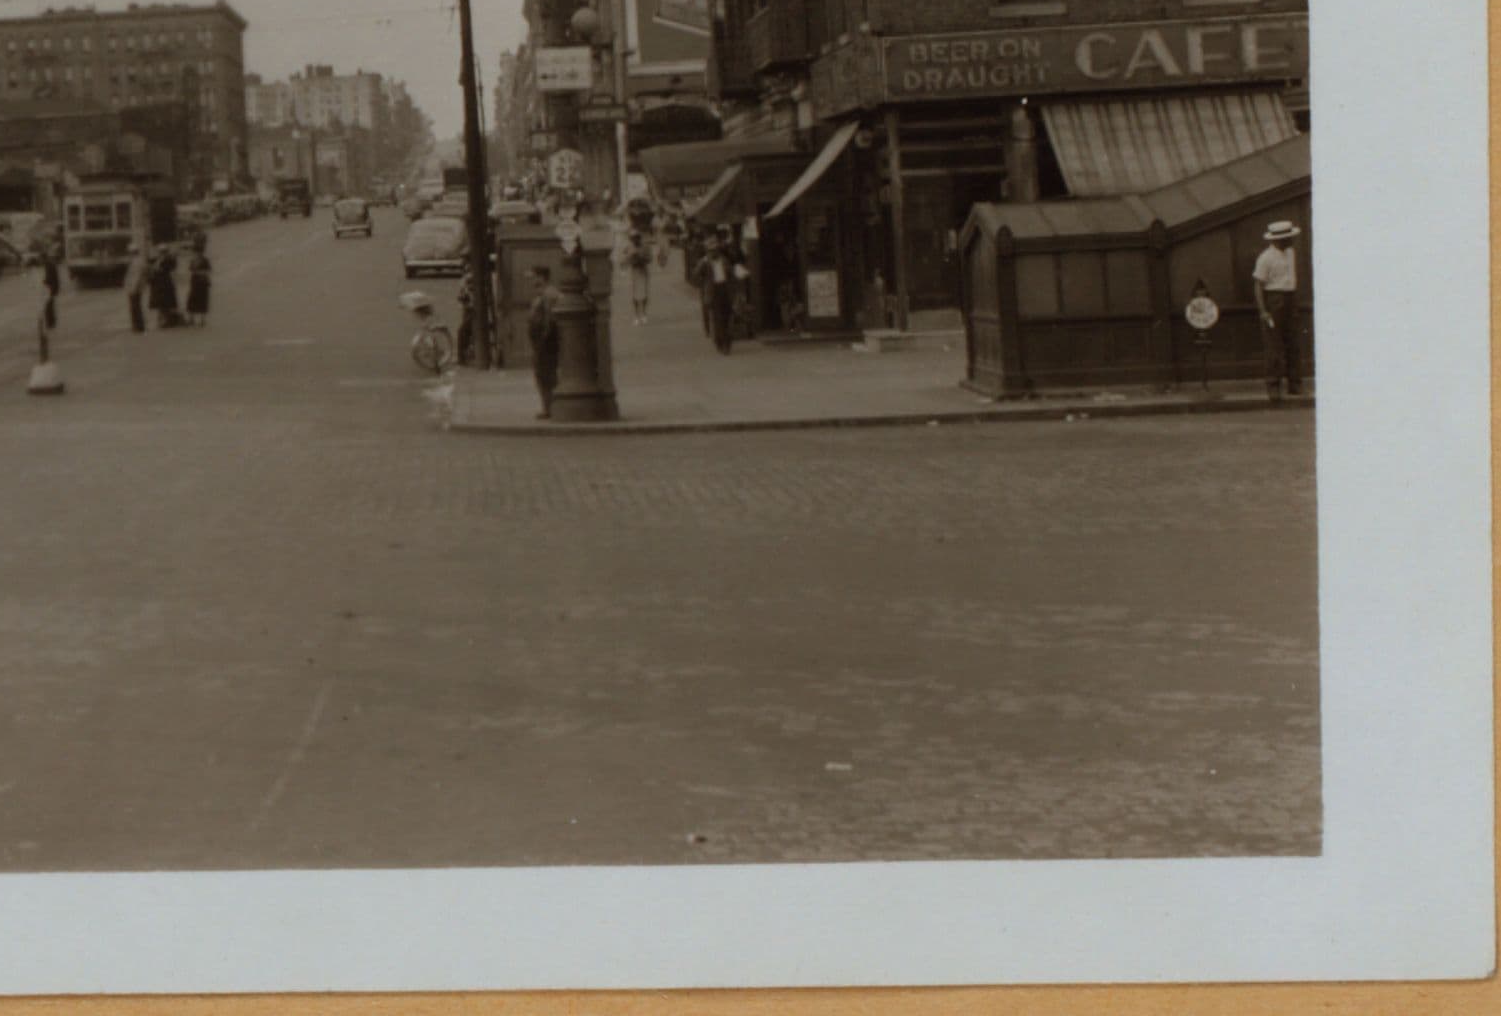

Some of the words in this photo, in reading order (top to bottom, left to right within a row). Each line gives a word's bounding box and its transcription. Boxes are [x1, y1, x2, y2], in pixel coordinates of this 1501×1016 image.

[908, 40, 989, 64] BEER
[998, 37, 1041, 59] ON
[1073, 20, 1309, 80] CAFE
[902, 62, 1051, 91] DRAUGHT
